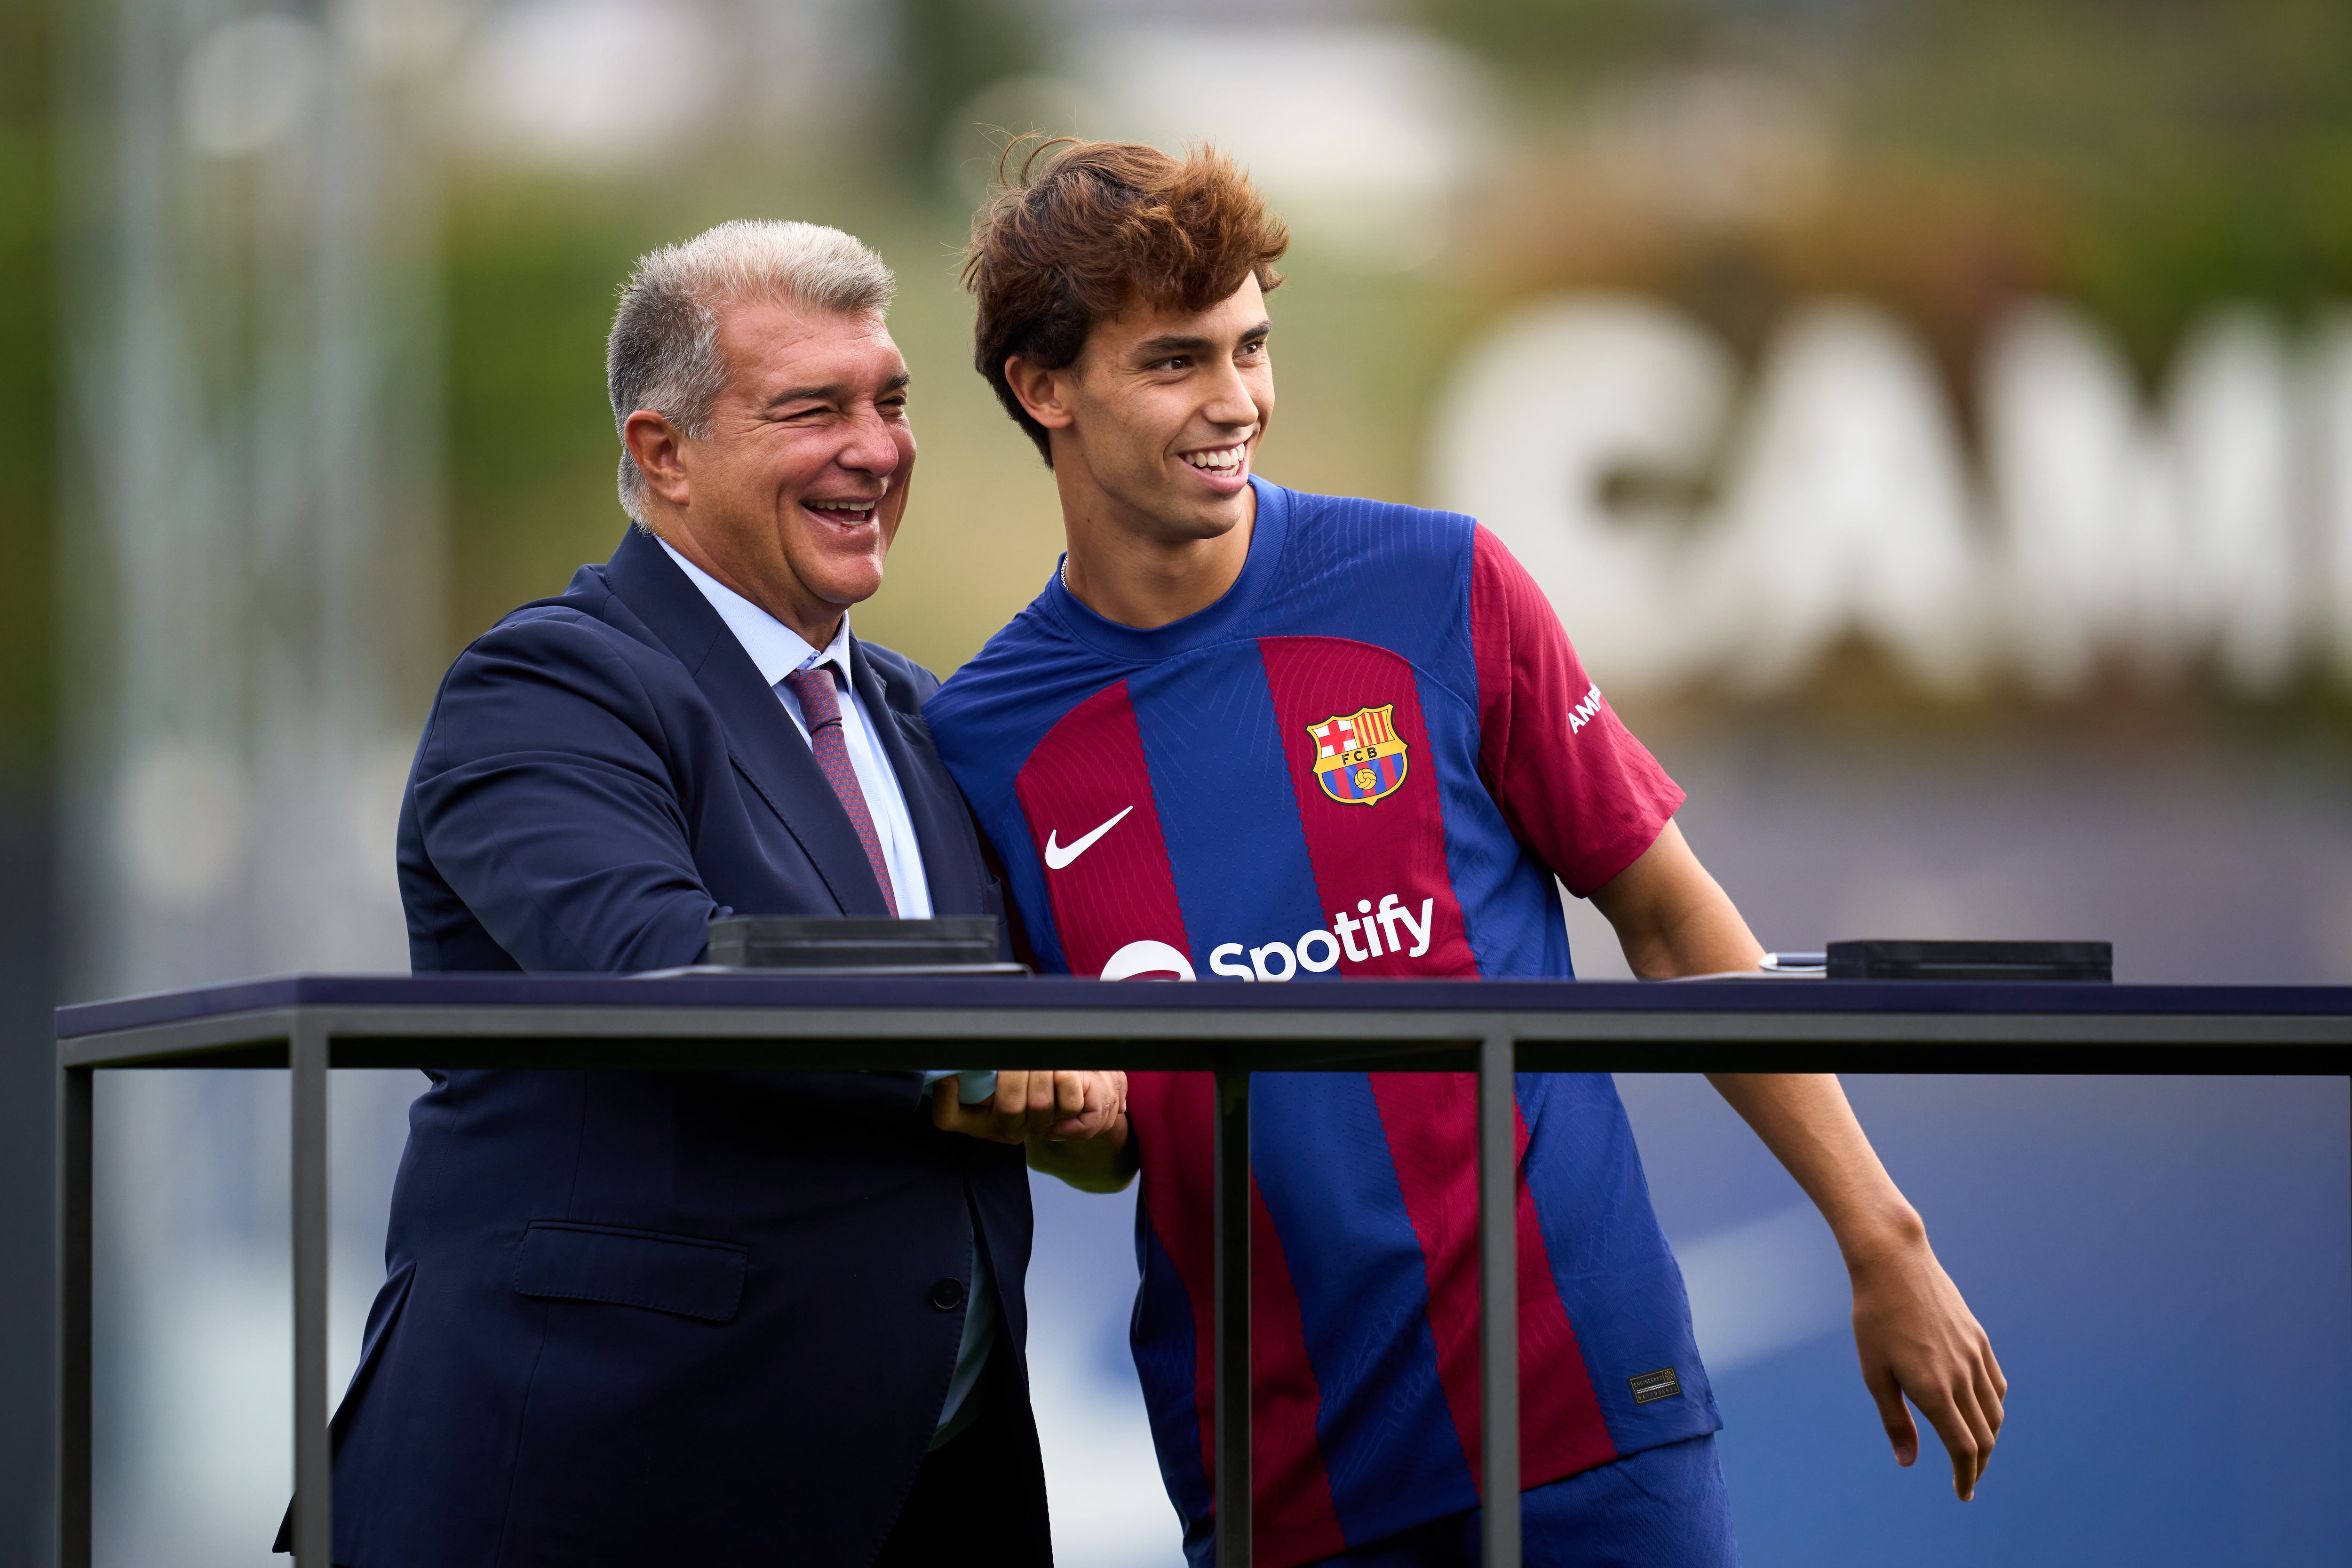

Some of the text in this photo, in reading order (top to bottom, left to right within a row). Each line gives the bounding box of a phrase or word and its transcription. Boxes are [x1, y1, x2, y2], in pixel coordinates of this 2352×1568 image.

[1435, 296, 2352, 694] CAM
[1209, 893, 1434, 982] Spotify
[1633, 1376, 1663, 1387] ENGINEERED
